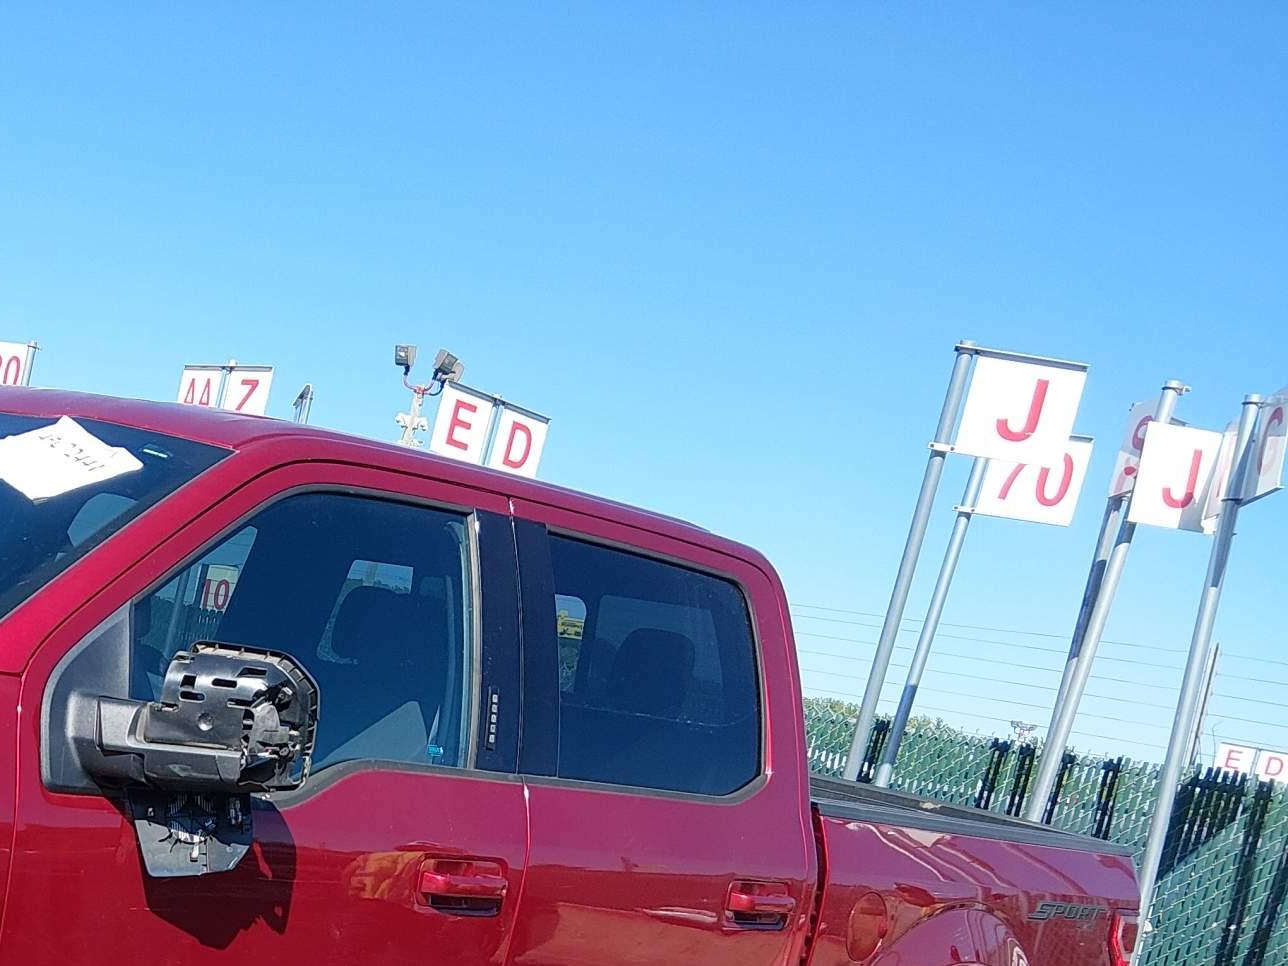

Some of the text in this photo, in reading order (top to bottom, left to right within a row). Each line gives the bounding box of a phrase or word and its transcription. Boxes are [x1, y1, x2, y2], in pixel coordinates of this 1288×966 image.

[235, 379, 260, 411] 7
[996, 378, 1050, 442] J
[445, 399, 478, 451] E
[502, 420, 532, 469] D
[1162, 448, 1203, 509] J
[1224, 749, 1244, 770] E
[1264, 756, 1284, 776] D
[1028, 901, 1107, 921] SPORT
